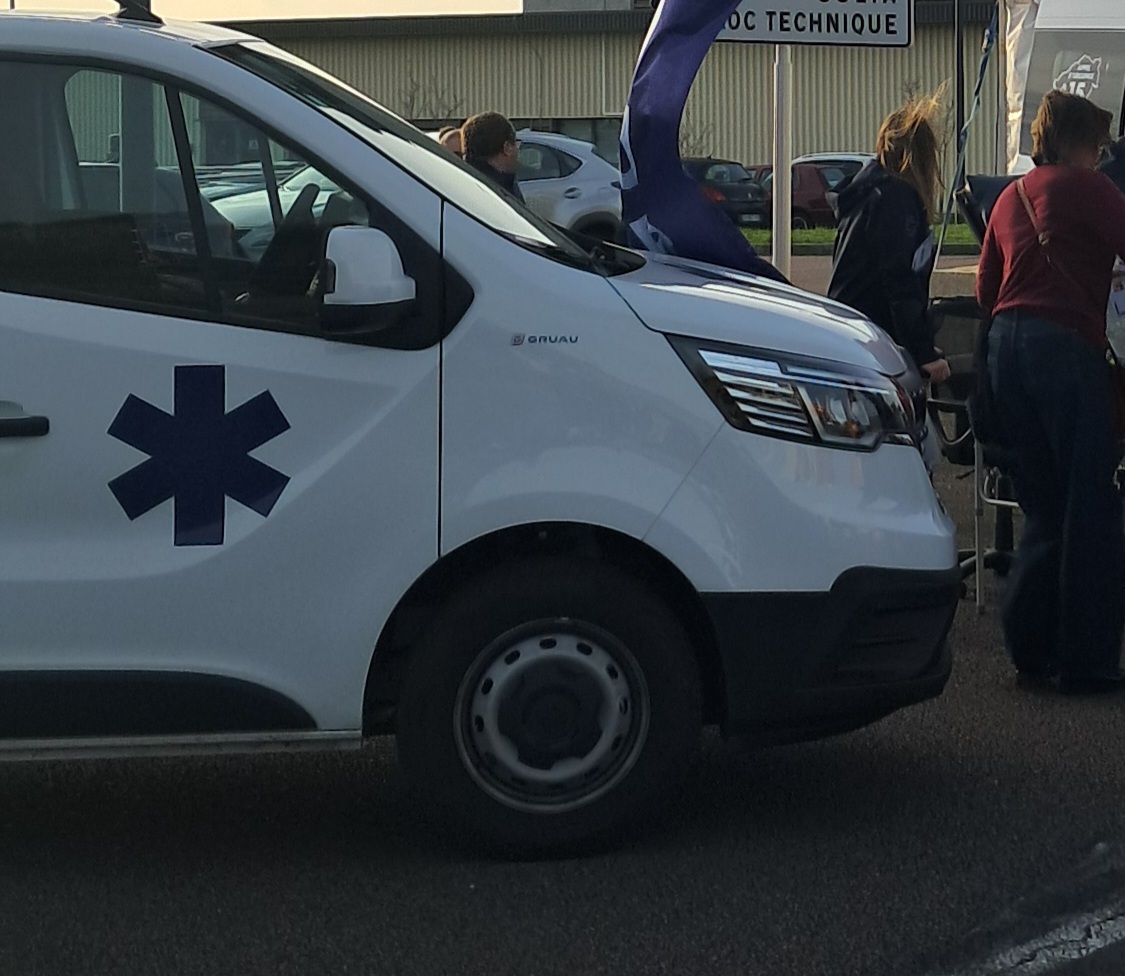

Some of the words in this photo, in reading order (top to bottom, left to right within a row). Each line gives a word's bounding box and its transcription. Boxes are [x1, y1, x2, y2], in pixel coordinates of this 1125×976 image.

[724, 10, 756, 31] OC
[766, 10, 898, 36] TECHNIQUE
[528, 335, 579, 344] GRUAU
